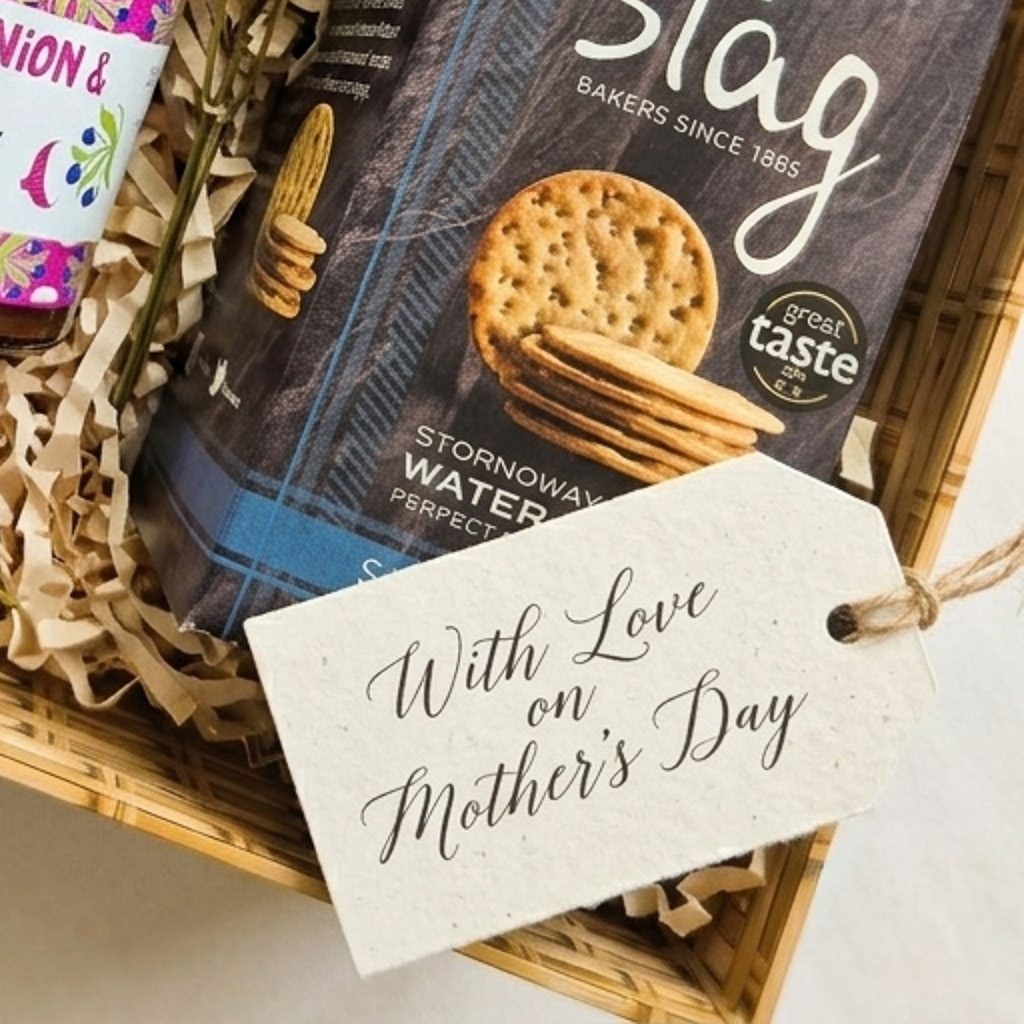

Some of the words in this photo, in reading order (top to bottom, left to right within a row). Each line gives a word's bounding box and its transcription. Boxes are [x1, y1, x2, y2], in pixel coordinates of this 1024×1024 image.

[86, 51, 112, 96] &
[576, 75, 670, 126] BAKERS
[673, 114, 745, 156] SINCE
[749, 314, 859, 385] taste
[404, 451, 548, 526] WATER
[415, 425, 603, 507] STORNOWAY
[366, 603, 549, 719] With
[564, 567, 718, 665] Love
[527, 684, 596, 727] on
[361, 729, 643, 864] Mother's
[652, 668, 808, 772] Day
